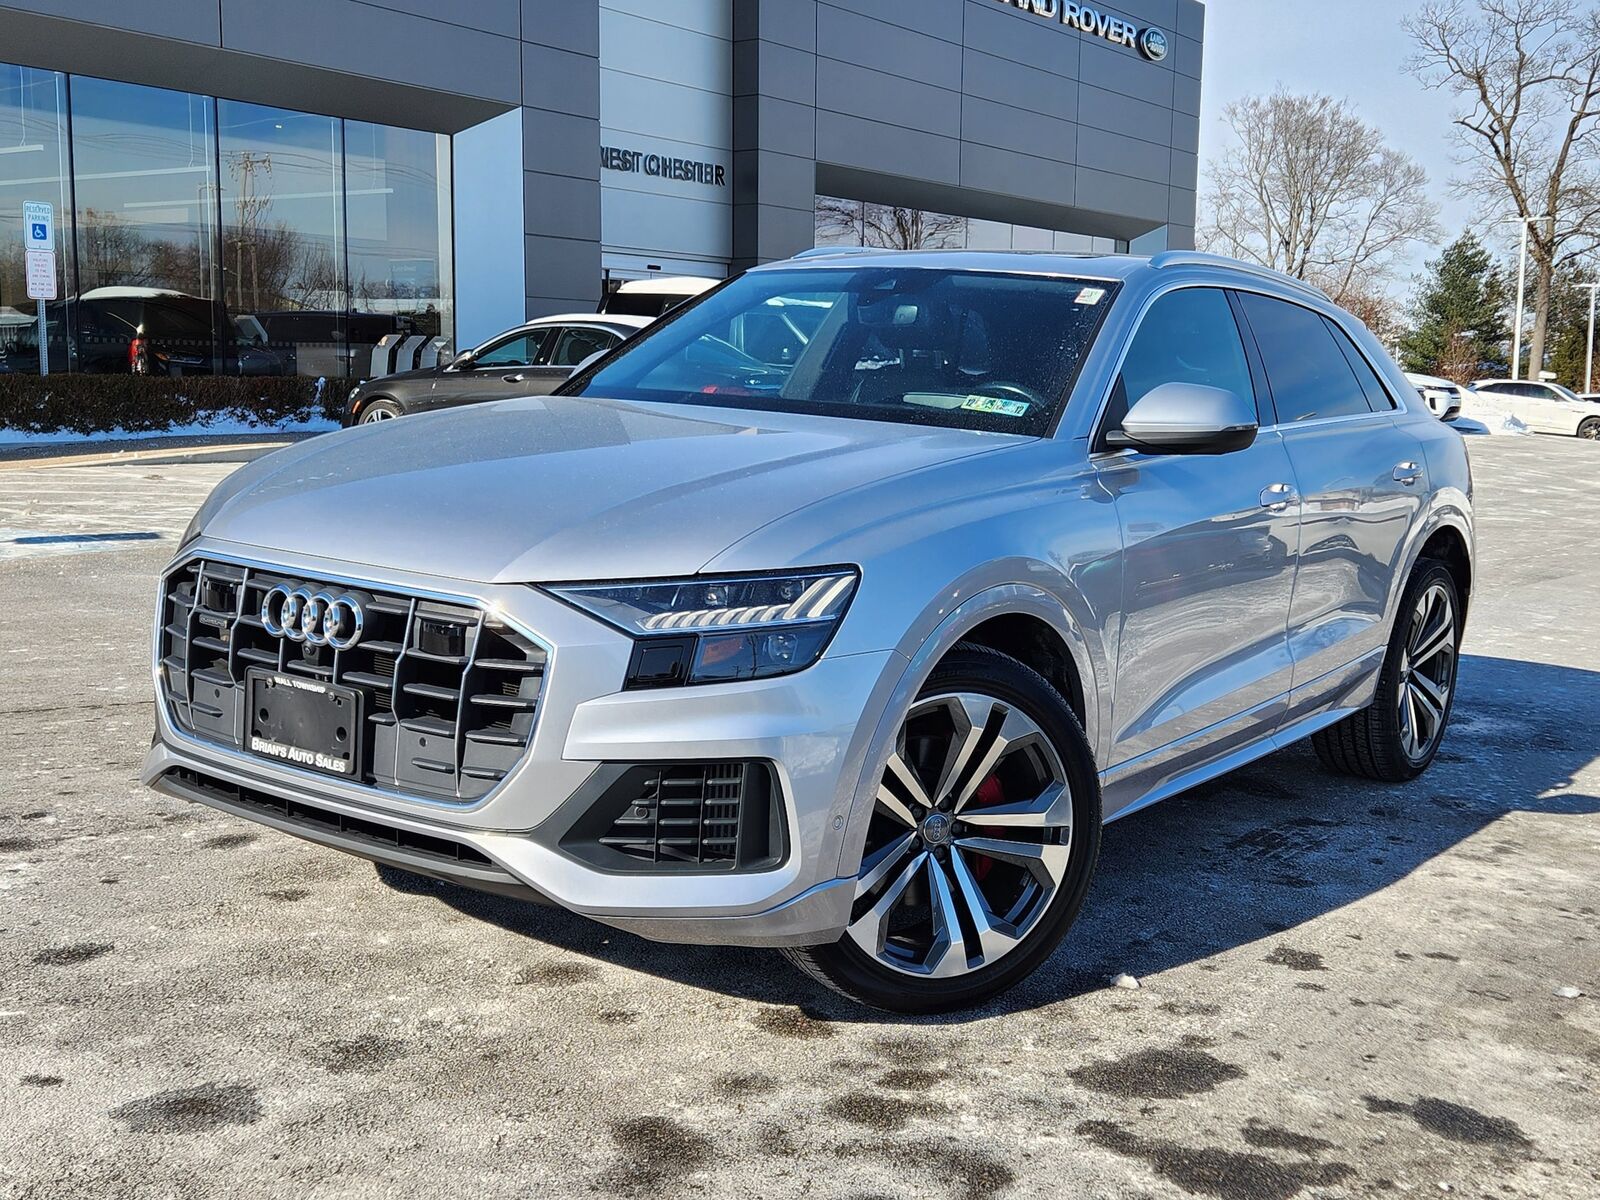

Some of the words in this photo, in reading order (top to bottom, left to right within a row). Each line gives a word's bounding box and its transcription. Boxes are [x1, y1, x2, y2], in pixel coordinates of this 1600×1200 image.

[1063, 0, 1138, 48] ROVER
[644, 154, 726, 187] CHESTER
[25, 205, 50, 214] RESERVED
[27, 214, 50, 222] PARKING
[274, 676, 293, 687] WALL
[292, 680, 326, 693] TOWNSHIP
[251, 737, 287, 758] BRIAN'S
[288, 747, 314, 764] AUTO
[315, 754, 346, 773] SALES
